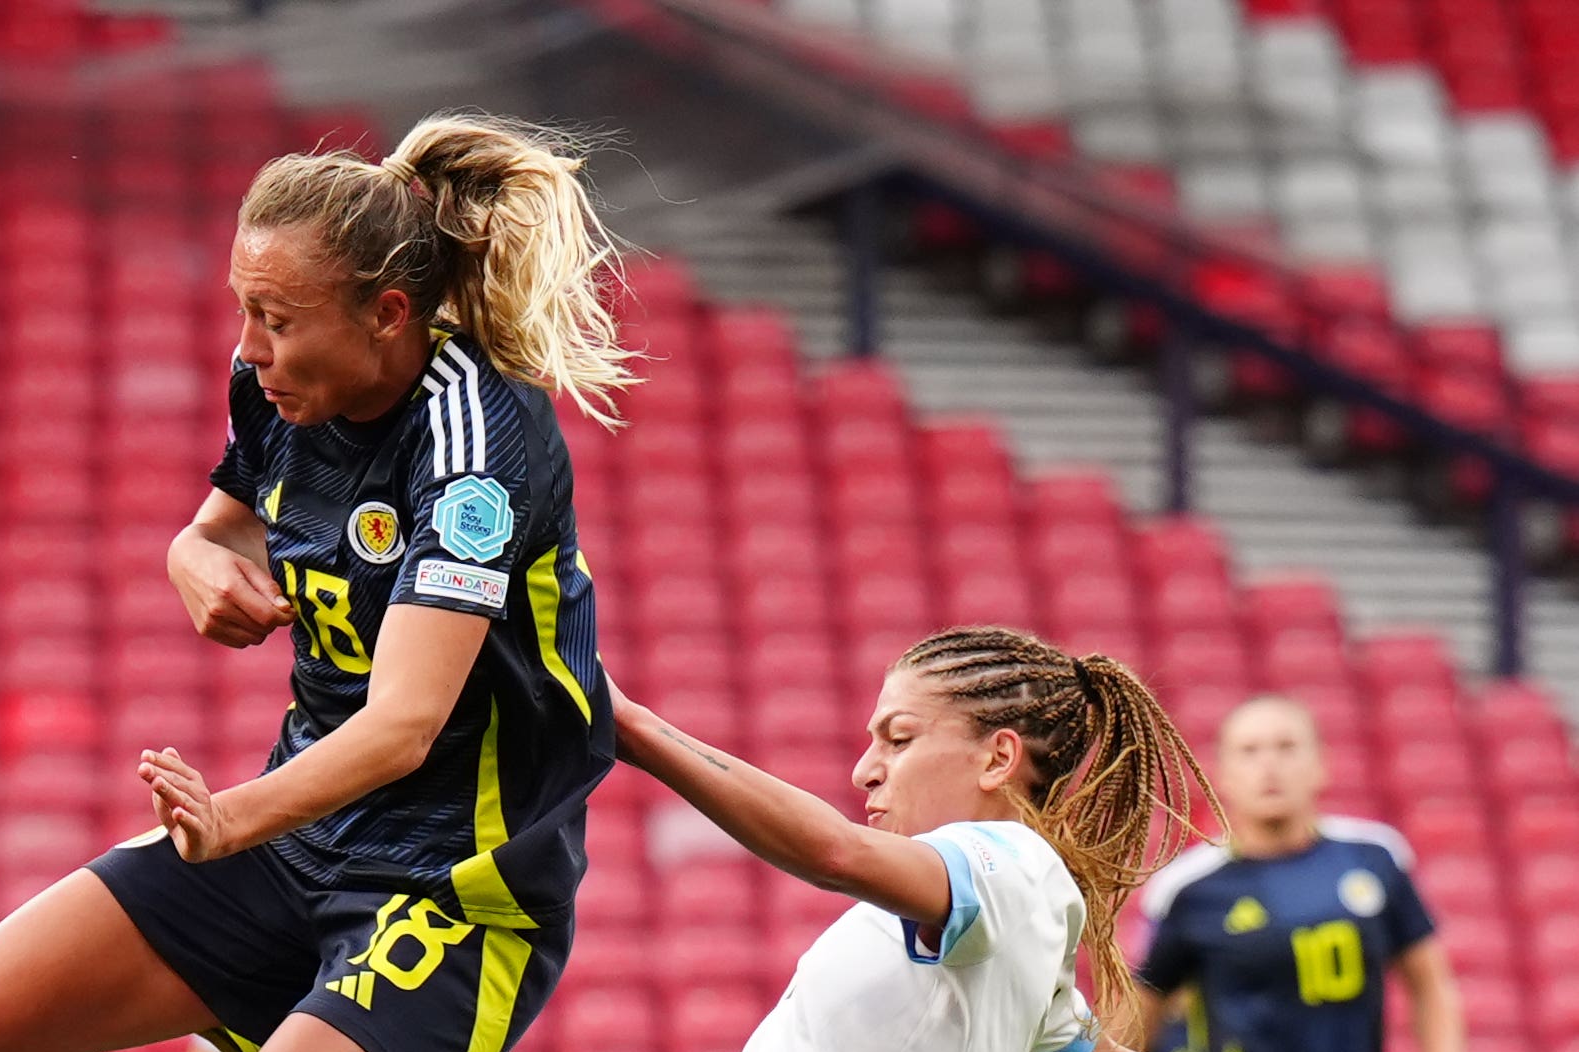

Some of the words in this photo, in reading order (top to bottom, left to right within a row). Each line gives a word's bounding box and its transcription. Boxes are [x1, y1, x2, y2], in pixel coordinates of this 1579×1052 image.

[283, 559, 373, 675] 18
[419, 571, 506, 597] FOUNDATION
[346, 893, 477, 991] 18
[1290, 919, 1367, 1007] 10
